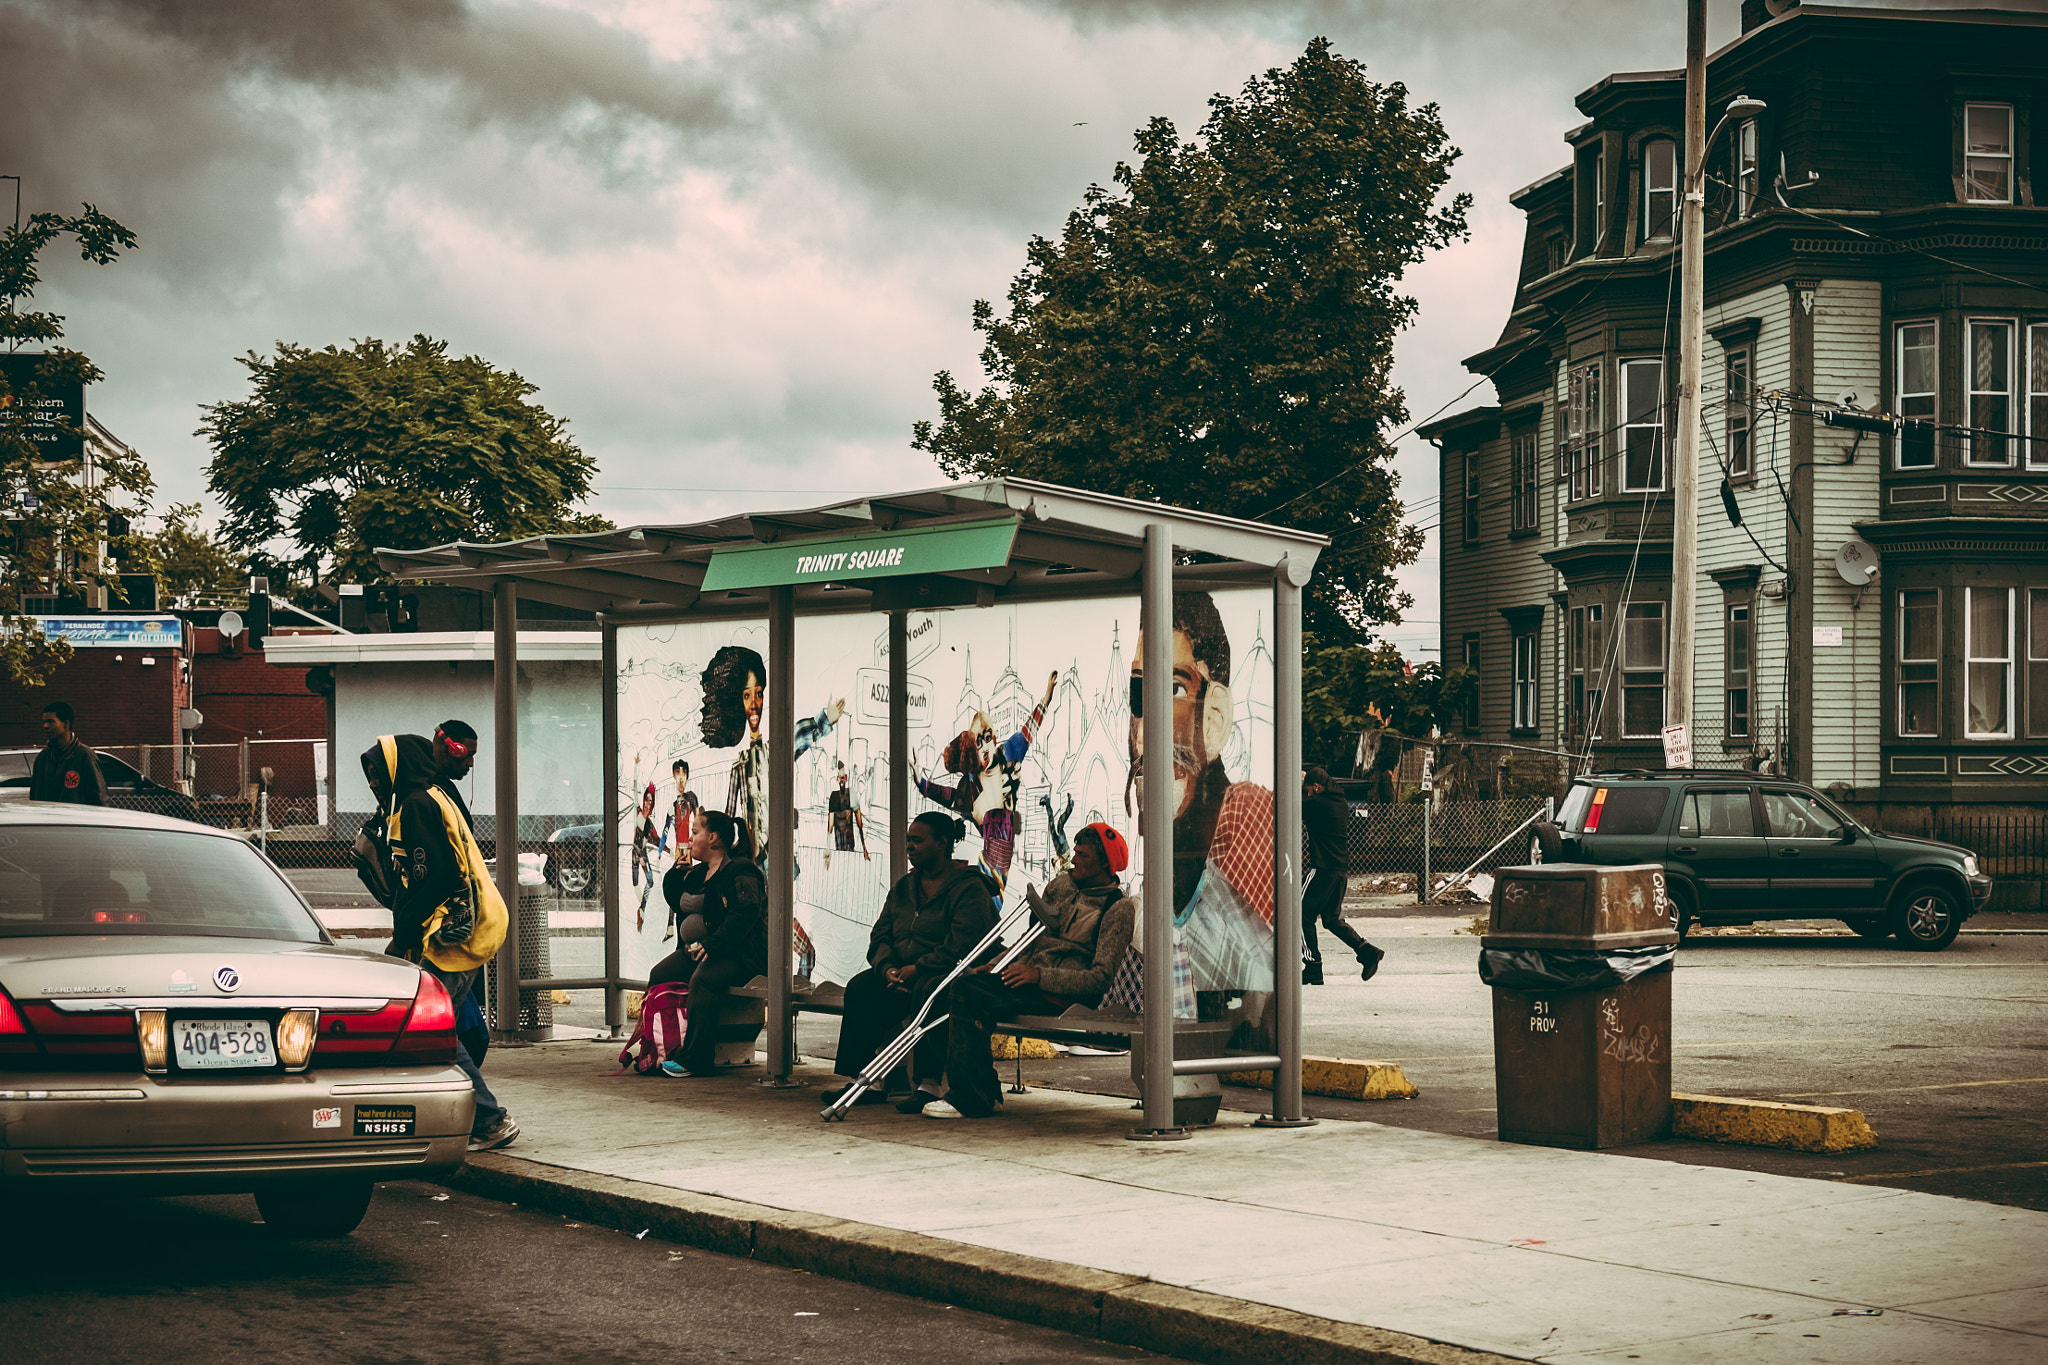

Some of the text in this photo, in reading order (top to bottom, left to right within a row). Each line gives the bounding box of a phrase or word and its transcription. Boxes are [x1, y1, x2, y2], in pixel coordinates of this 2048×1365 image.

[796, 547, 905, 574] TRINITY SQUARE
[57, 629, 115, 640] SQUARE
[906, 617, 934, 642] Youth
[128, 630, 175, 643] Corona
[1667, 745, 1688, 755] PARKING
[1674, 755, 1684, 763] NO
[41, 985, 128, 995] GRAND MARQUIS GS
[196, 1022, 248, 1032] Rhode Island
[1530, 1016, 1559, 1033] PROV.
[182, 1031, 267, 1056] 404-528
[203, 1057, 229, 1067] Ocean
[230, 1056, 252, 1066] State
[357, 1109, 371, 1118] Proud
[371, 1109, 387, 1118] Parent
[364, 1123, 407, 1133] NSHSS
